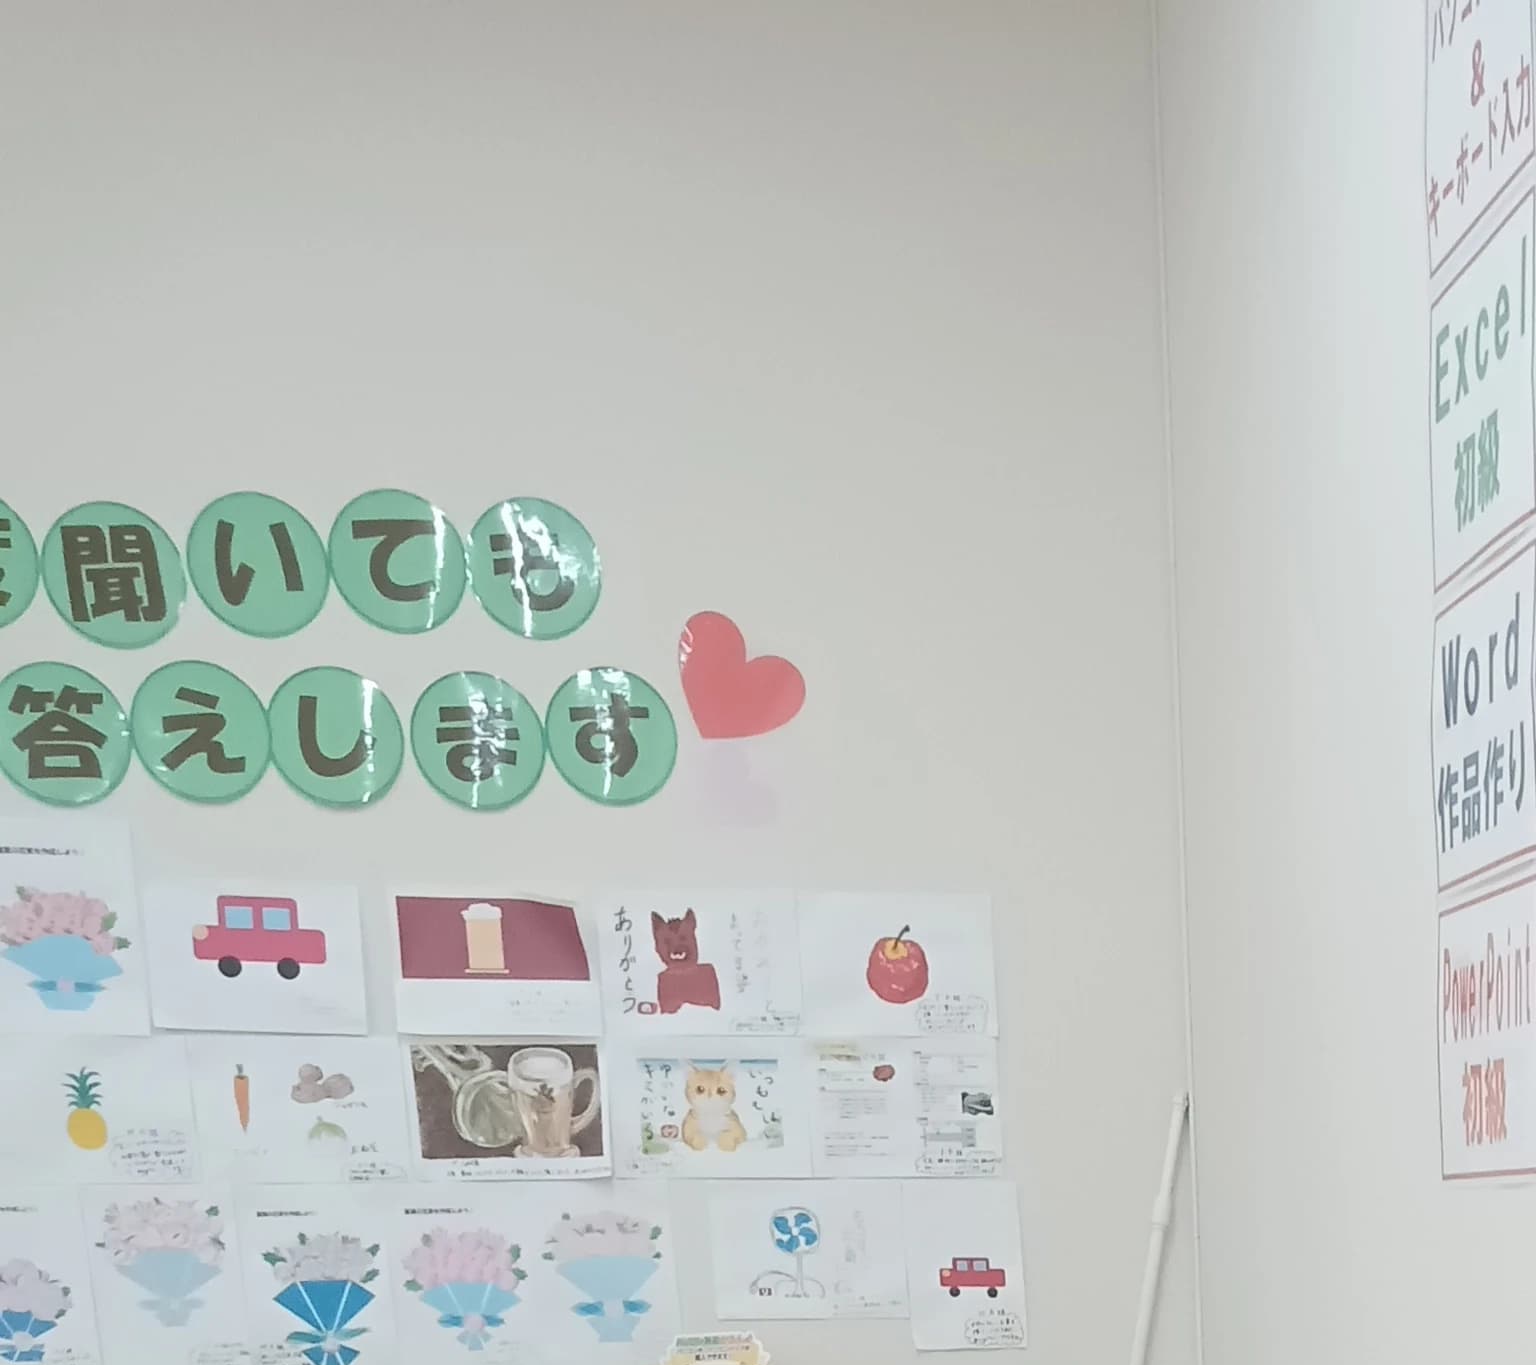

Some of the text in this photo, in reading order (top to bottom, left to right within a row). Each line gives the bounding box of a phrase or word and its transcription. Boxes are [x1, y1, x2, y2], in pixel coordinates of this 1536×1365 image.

[1471, 39, 1485, 107] &
[1429, 54, 1531, 238] キーボード入力
[1434, 234, 1528, 425] Excel
[1453, 408, 1501, 533] 初級
[0, 518, 576, 622] 聞いても
[1441, 592, 1521, 729] Word
[8, 683, 650, 782] 答えします
[1437, 721, 1525, 854] 作品作り
[1443, 923, 1531, 1044] PowerPoint
[1461, 1057, 1508, 1147] 初級
